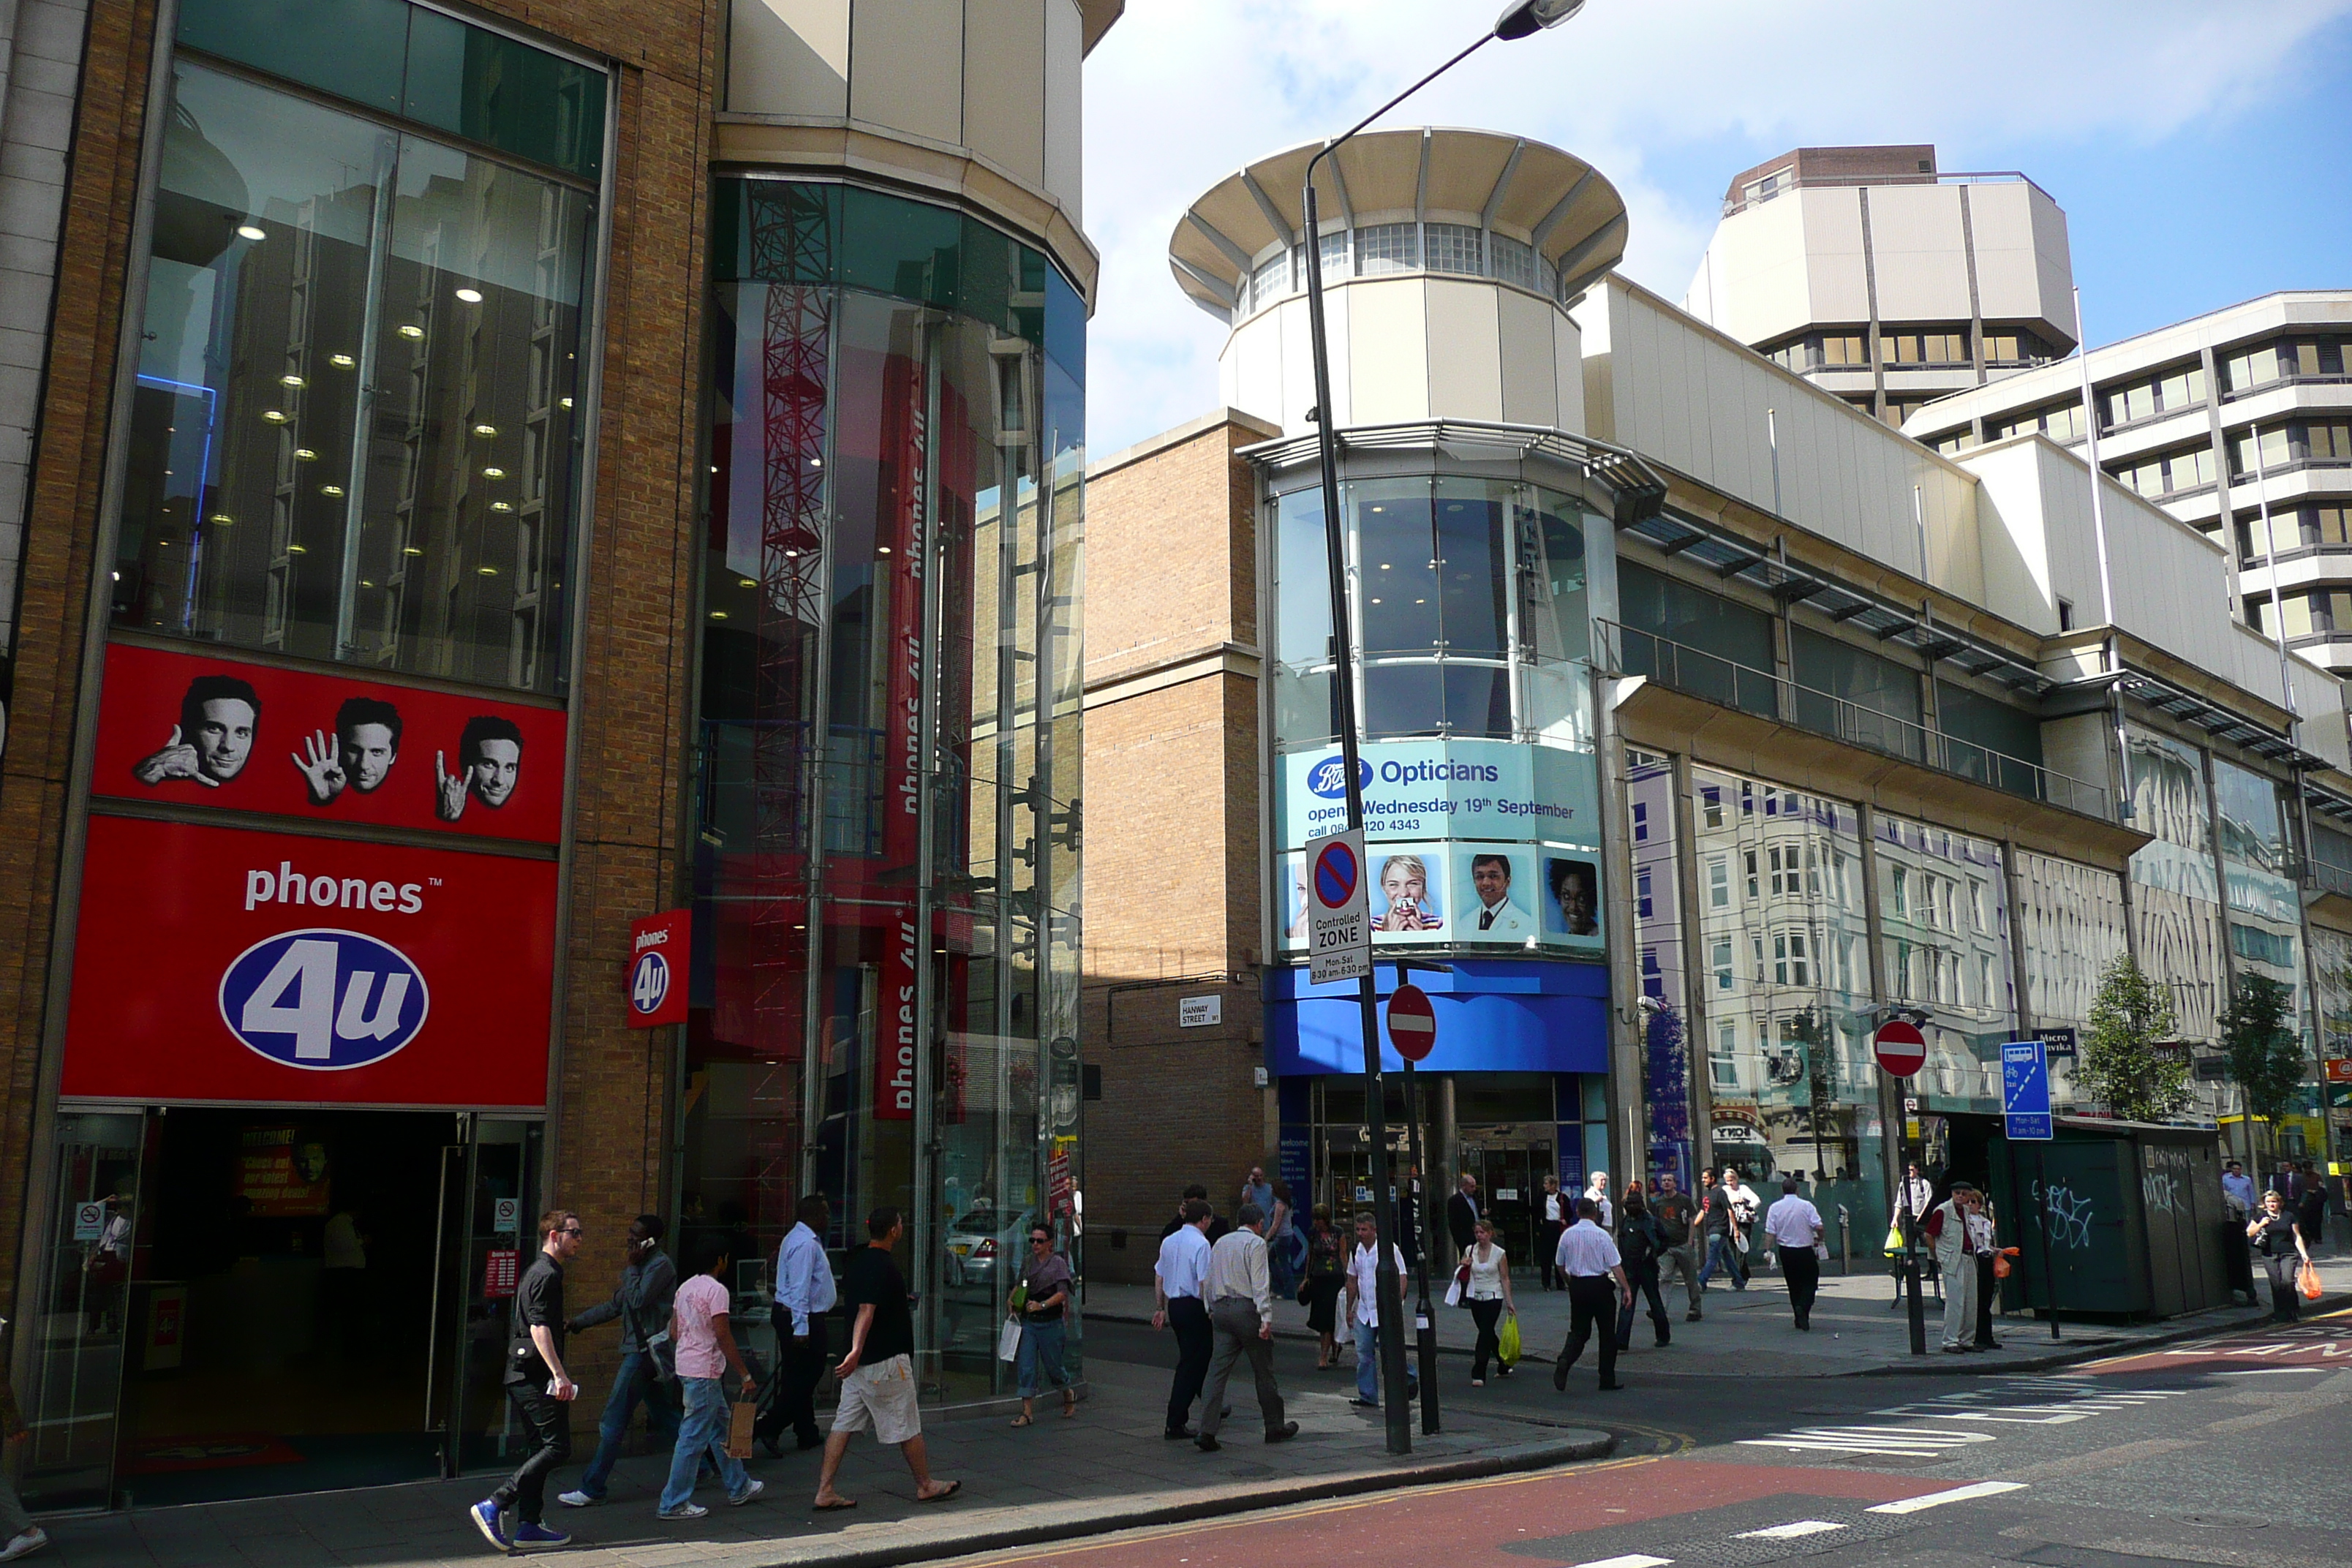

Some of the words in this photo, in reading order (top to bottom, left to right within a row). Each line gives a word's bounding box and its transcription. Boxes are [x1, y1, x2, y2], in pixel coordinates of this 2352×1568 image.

[1313, 762, 1362, 793] Bos
[1381, 758, 1499, 786] Opticians
[1308, 806, 1349, 823] open
[1362, 797, 1458, 815] Wednesday
[1464, 797, 1492, 813] 19th
[1497, 798, 1575, 820] September
[1308, 825, 1327, 837] call
[1330, 823, 1350, 834] 08
[1389, 819, 1420, 830] 4343
[245, 861, 423, 914] phones
[1316, 911, 1360, 930] Controlled
[636, 929, 668, 953] phones
[1319, 926, 1358, 948] ZONE
[1358, 964, 1368, 974] pm
[633, 957, 664, 1009] 4u
[241, 939, 412, 1059] 4u
[1183, 1005, 1208, 1014] HANWAY
[1183, 1014, 1205, 1024] STREET
[2040, 1033, 2068, 1043] Micro
[2046, 1042, 2073, 1052] nvika
[1375, 1072, 1382, 1082] 4
[243, 1129, 296, 1147] WELCOME!
[1281, 1138, 1308, 1147] welcome
[263, 1171, 289, 1184] latest
